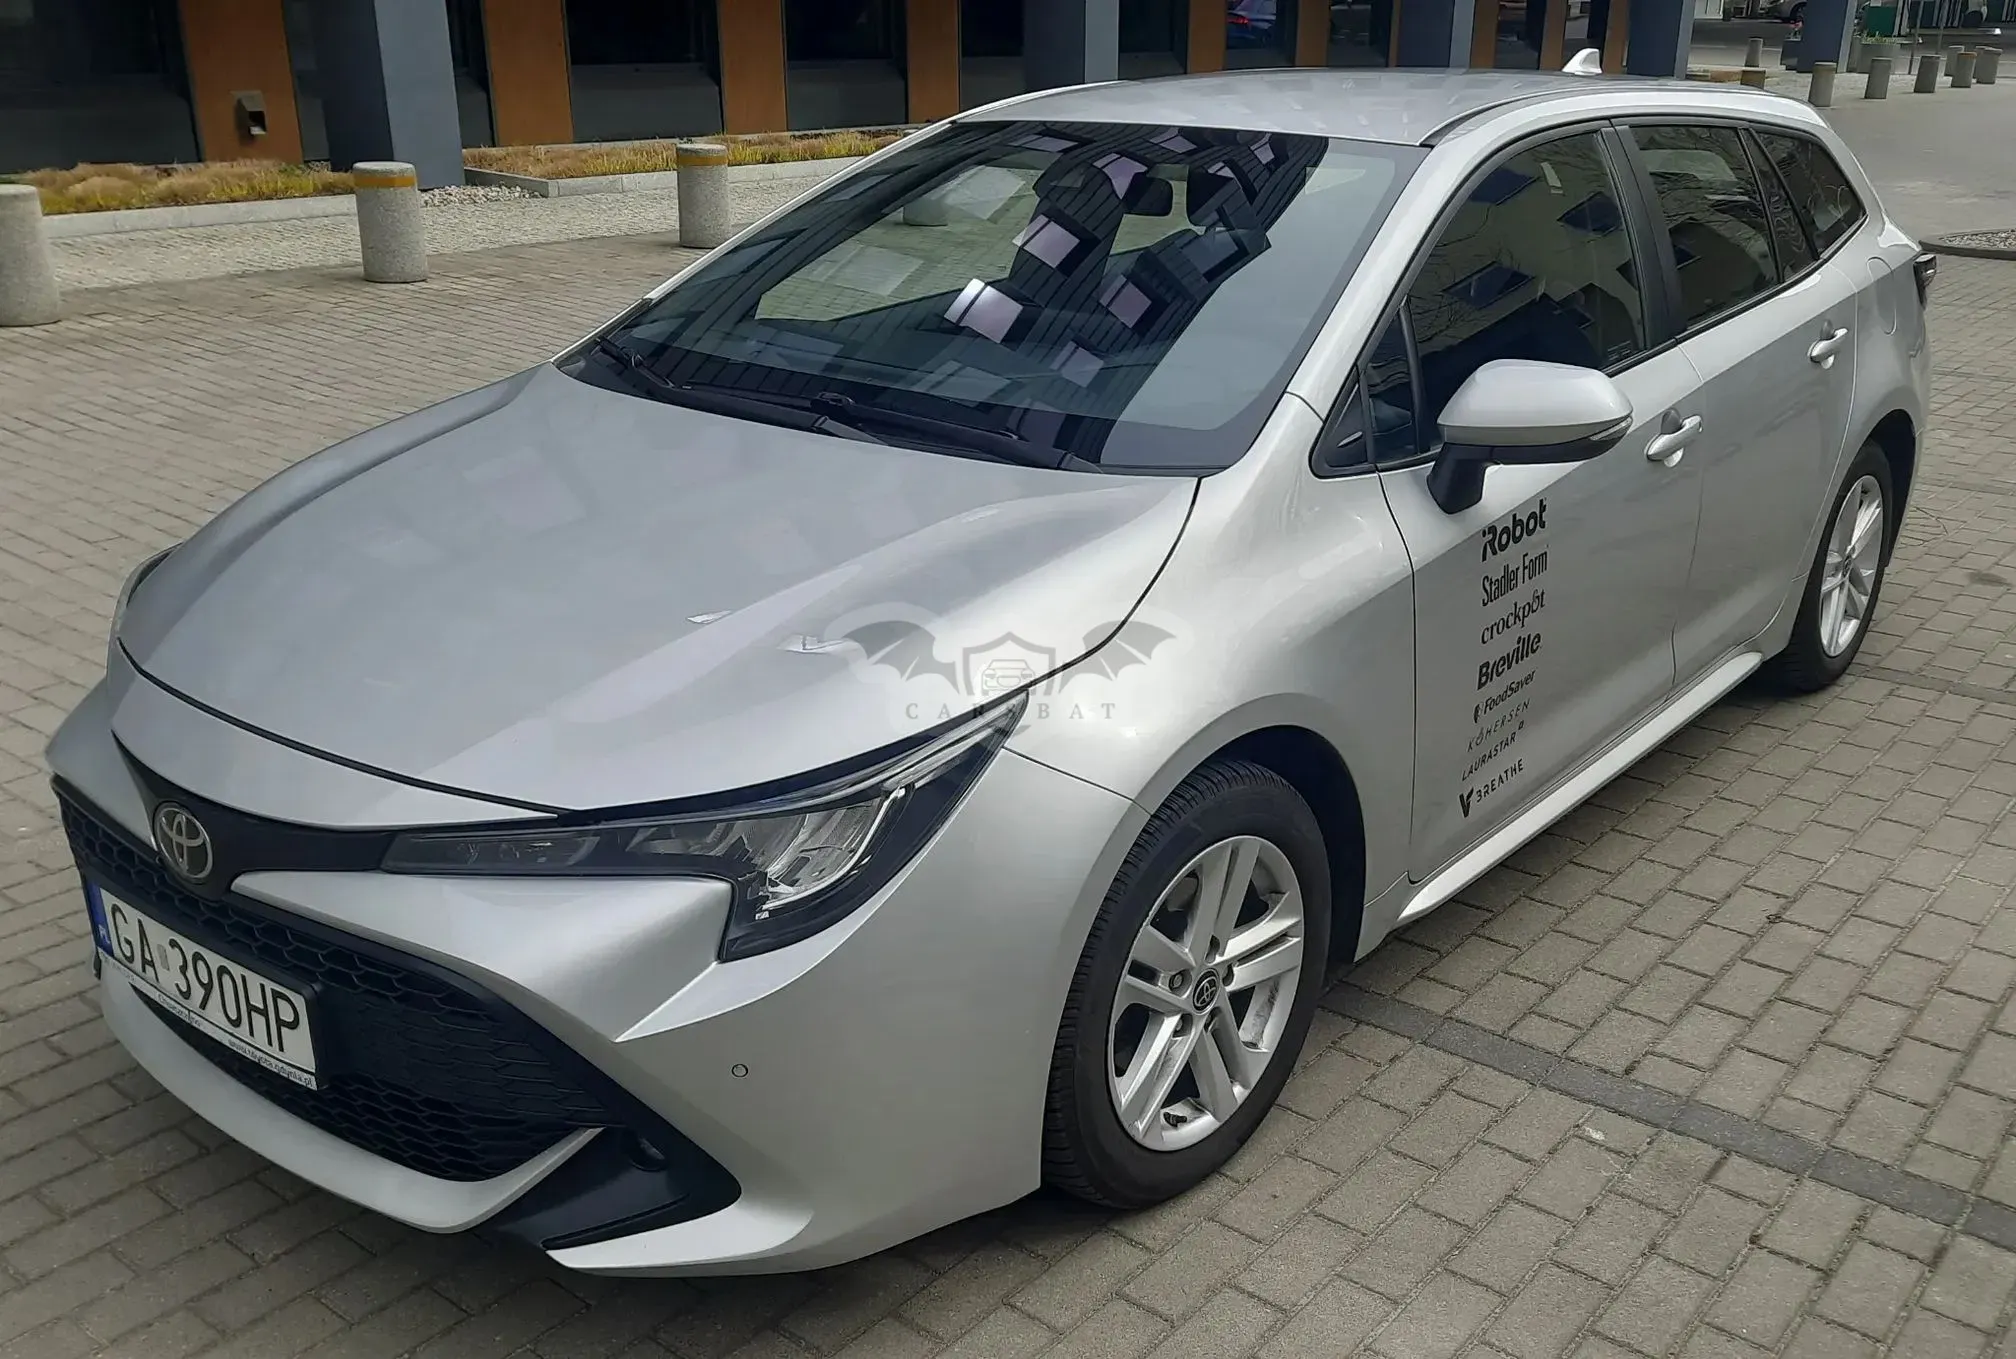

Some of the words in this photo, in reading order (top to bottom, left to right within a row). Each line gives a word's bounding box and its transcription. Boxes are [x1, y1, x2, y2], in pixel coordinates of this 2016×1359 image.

[1482, 563, 1520, 607] Stadler
[1522, 551, 1548, 585] Form
[1477, 632, 1541, 691] Breville
[1483, 669, 1537, 715] FoodSaver
[1462, 731, 1517, 782] LAURASTAR
[111, 903, 160, 984] GA
[168, 938, 300, 1053] 390HP
